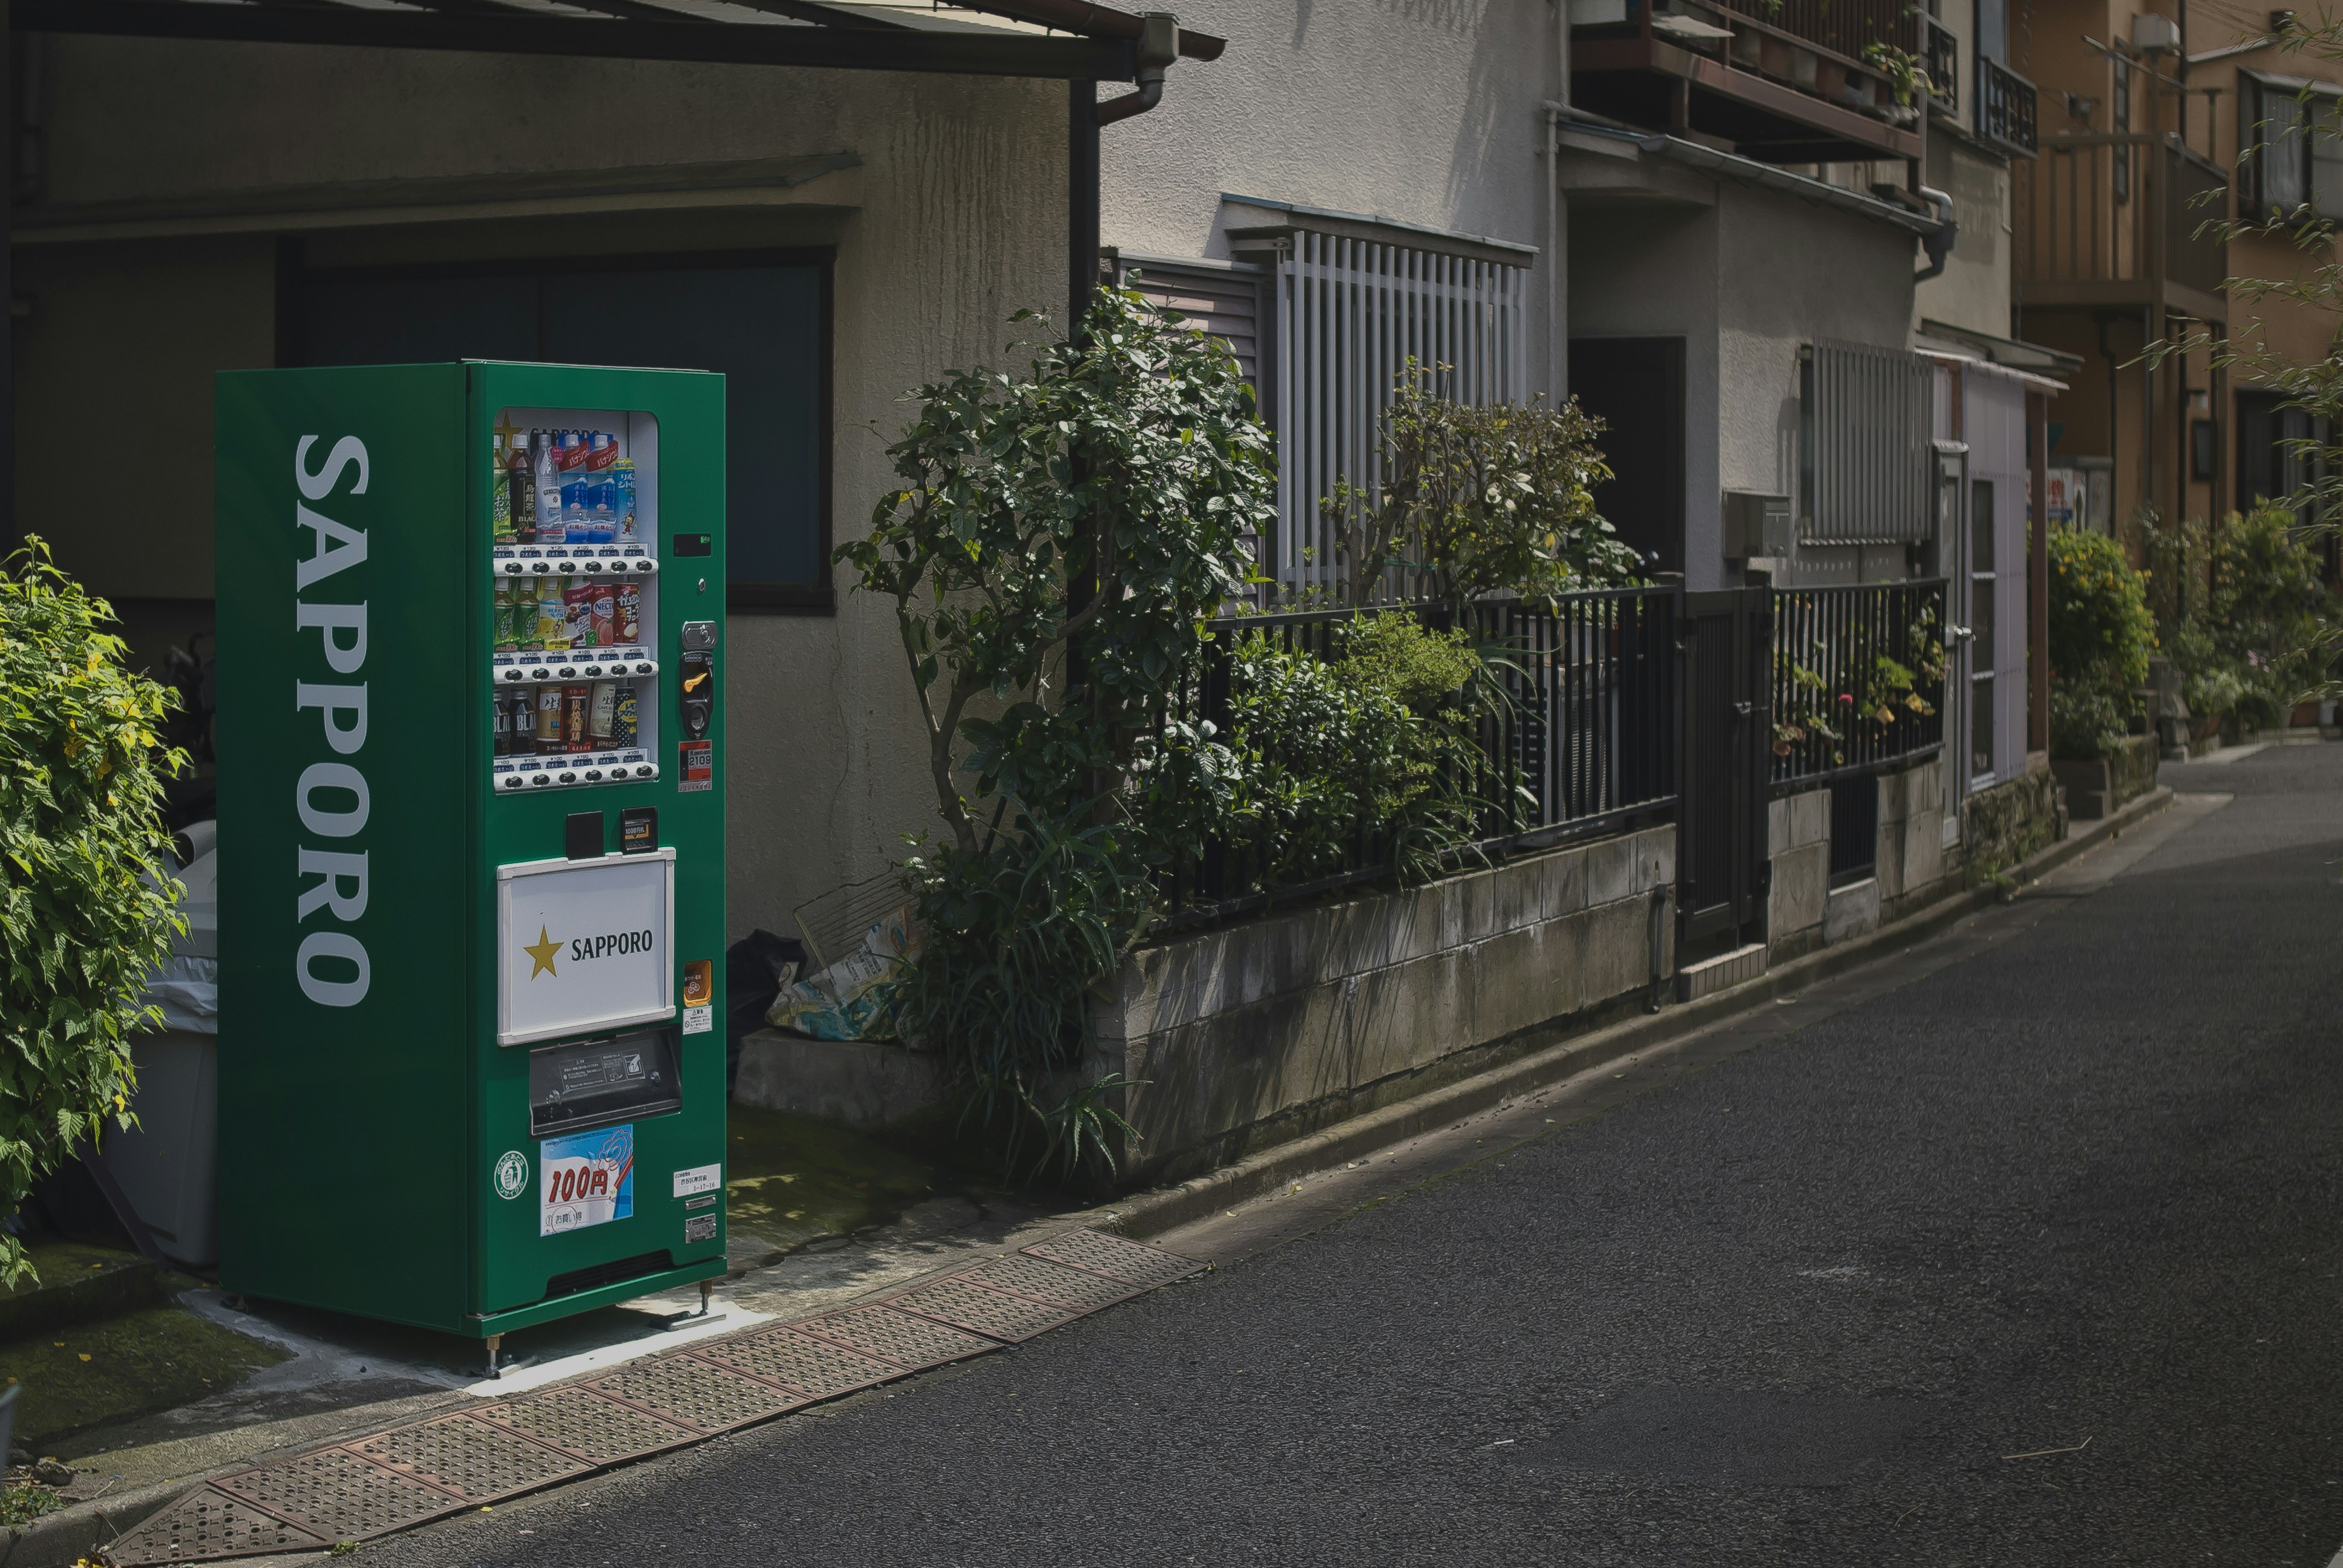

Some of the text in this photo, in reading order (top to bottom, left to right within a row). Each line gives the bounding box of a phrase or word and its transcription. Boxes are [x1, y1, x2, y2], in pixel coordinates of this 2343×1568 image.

[295, 434, 370, 1007] SAPPORO
[689, 755, 712, 766] 2109
[571, 929, 653, 962] SAPPORO
[548, 1166, 609, 1203] 100円
